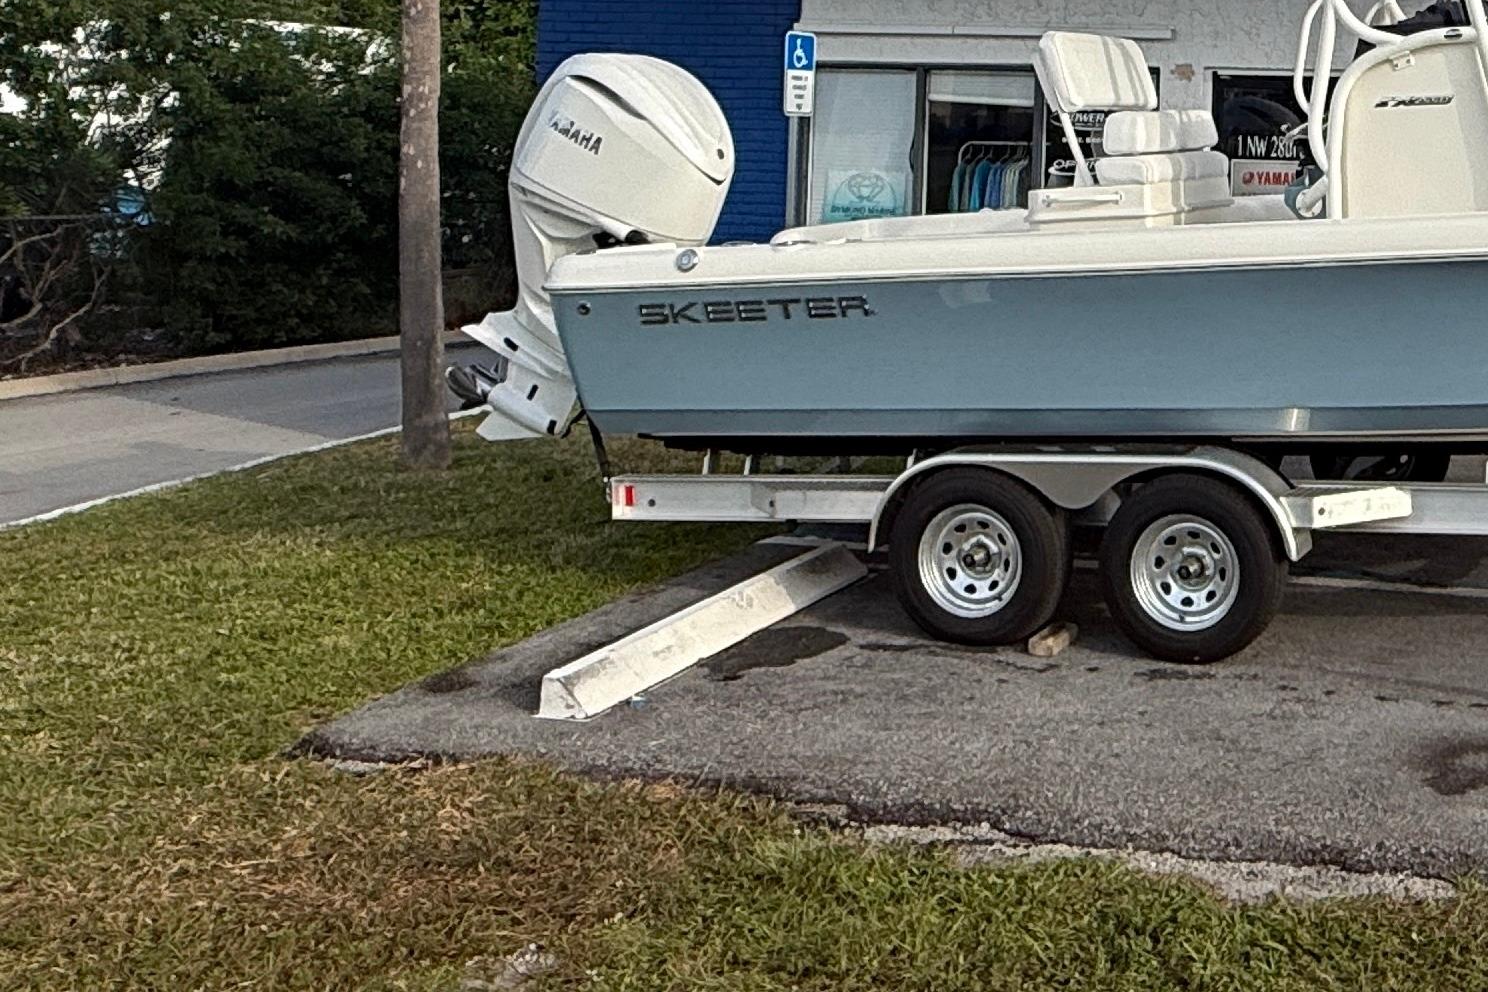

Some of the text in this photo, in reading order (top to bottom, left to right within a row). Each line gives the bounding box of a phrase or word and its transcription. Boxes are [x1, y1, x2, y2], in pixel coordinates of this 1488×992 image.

[1247, 135, 1269, 157] NW
[1256, 171, 1296, 185] YAMA
[639, 295, 872, 325] SKEETER
